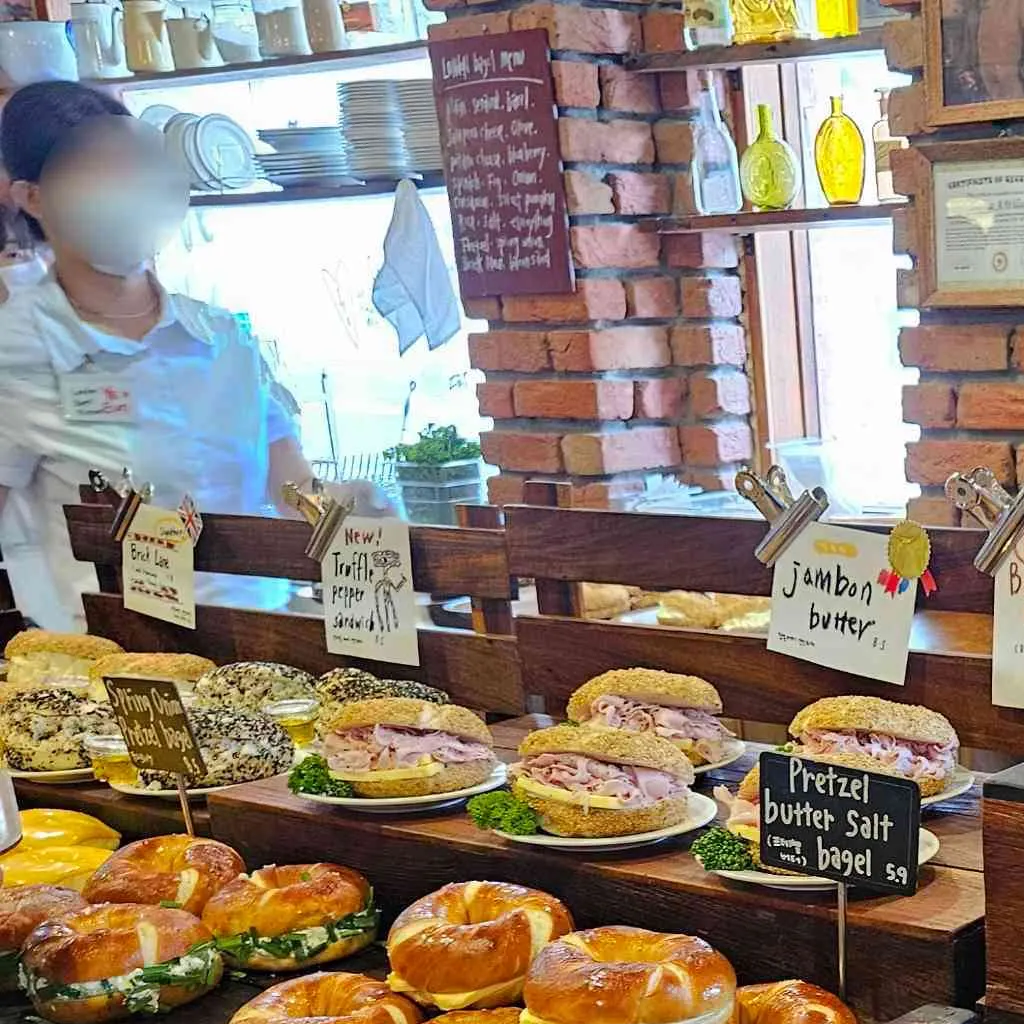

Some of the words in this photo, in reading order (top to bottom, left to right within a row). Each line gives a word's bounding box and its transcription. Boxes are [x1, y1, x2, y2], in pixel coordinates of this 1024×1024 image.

[345, 527, 382, 547] New!
[783, 561, 872, 606] jambon
[809, 603, 875, 640] butter
[789, 757, 869, 804] Pretzel
[764, 788, 835, 831] butter
[816, 835, 871, 877] bagel
[885, 862, 908, 885] 5.9
